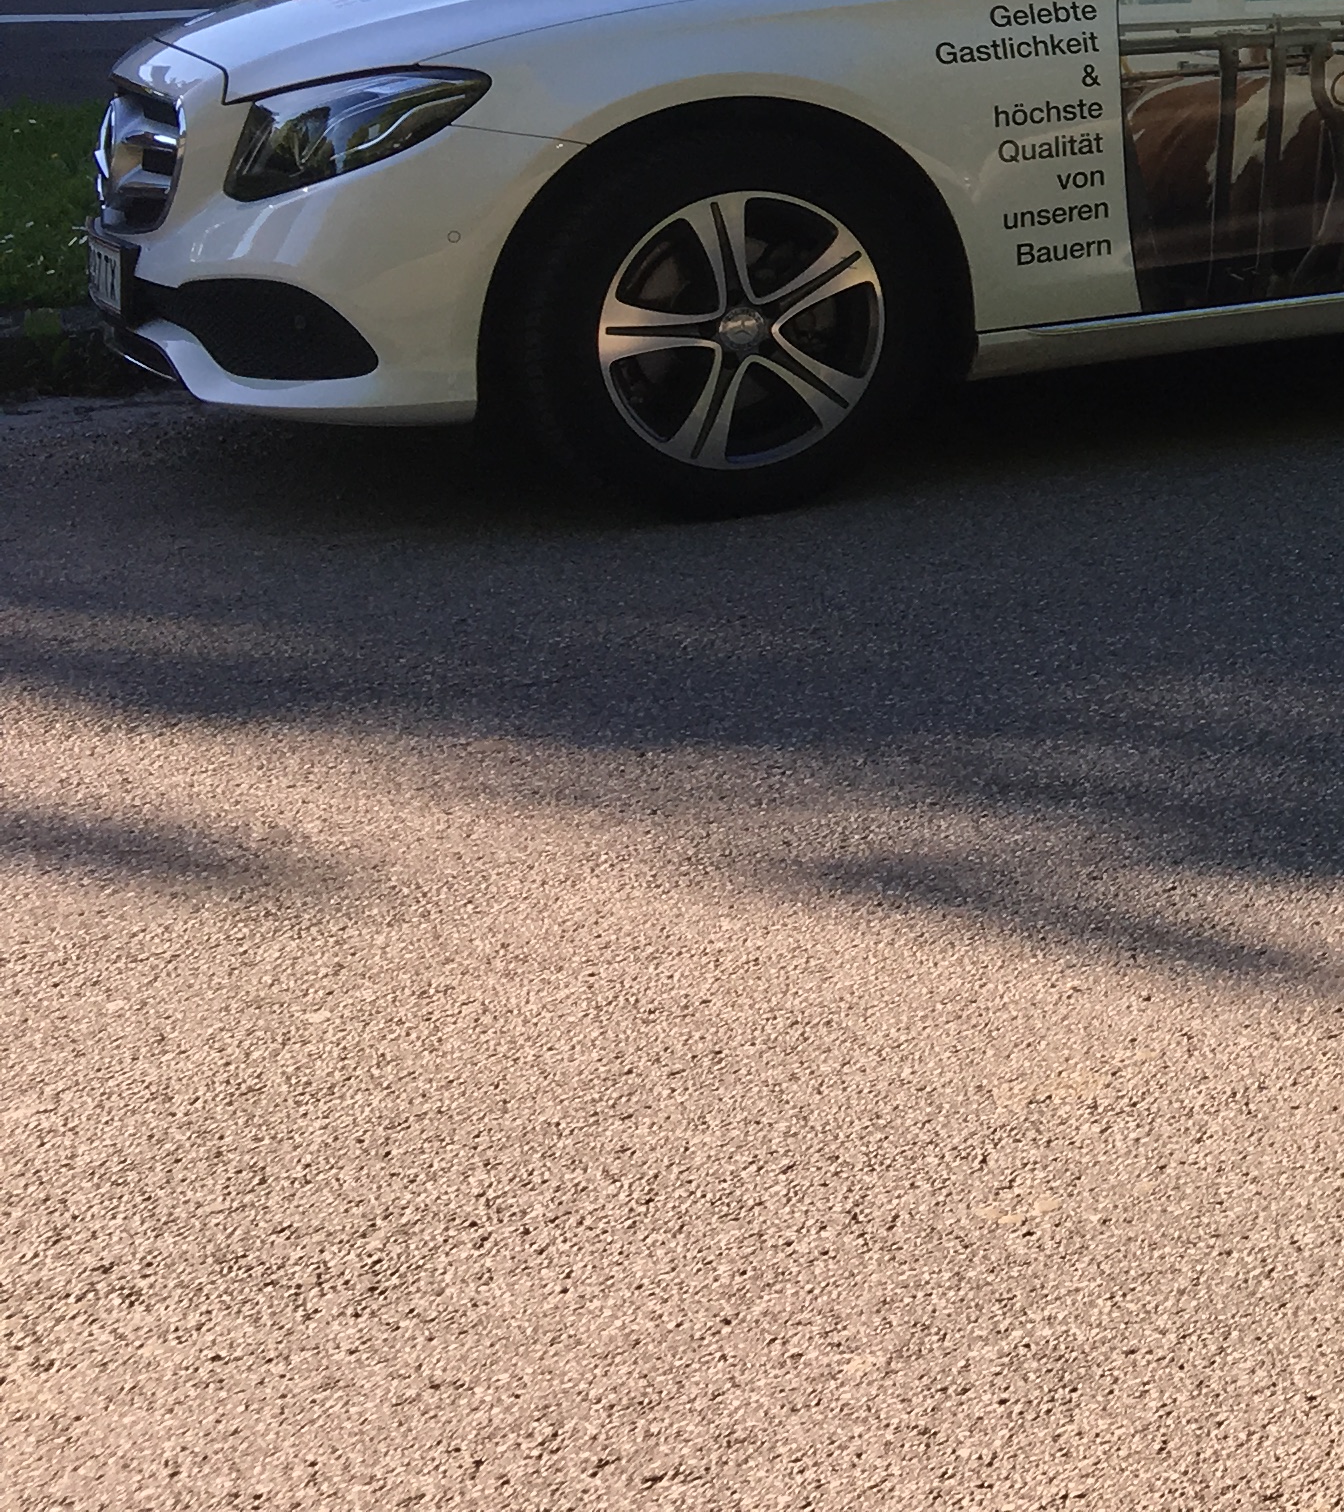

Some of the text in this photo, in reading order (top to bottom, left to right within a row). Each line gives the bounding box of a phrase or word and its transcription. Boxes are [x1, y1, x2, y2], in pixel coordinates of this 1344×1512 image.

[989, 1, 1097, 28] Gelebte
[935, 31, 1100, 65] Gastlichkeit
[1081, 64, 1102, 88] &
[993, 99, 1103, 128] höchste
[998, 132, 1104, 163] Qualität
[1056, 169, 1105, 190] von
[1003, 201, 1109, 230] unseren
[1016, 237, 1112, 266] Bauern
